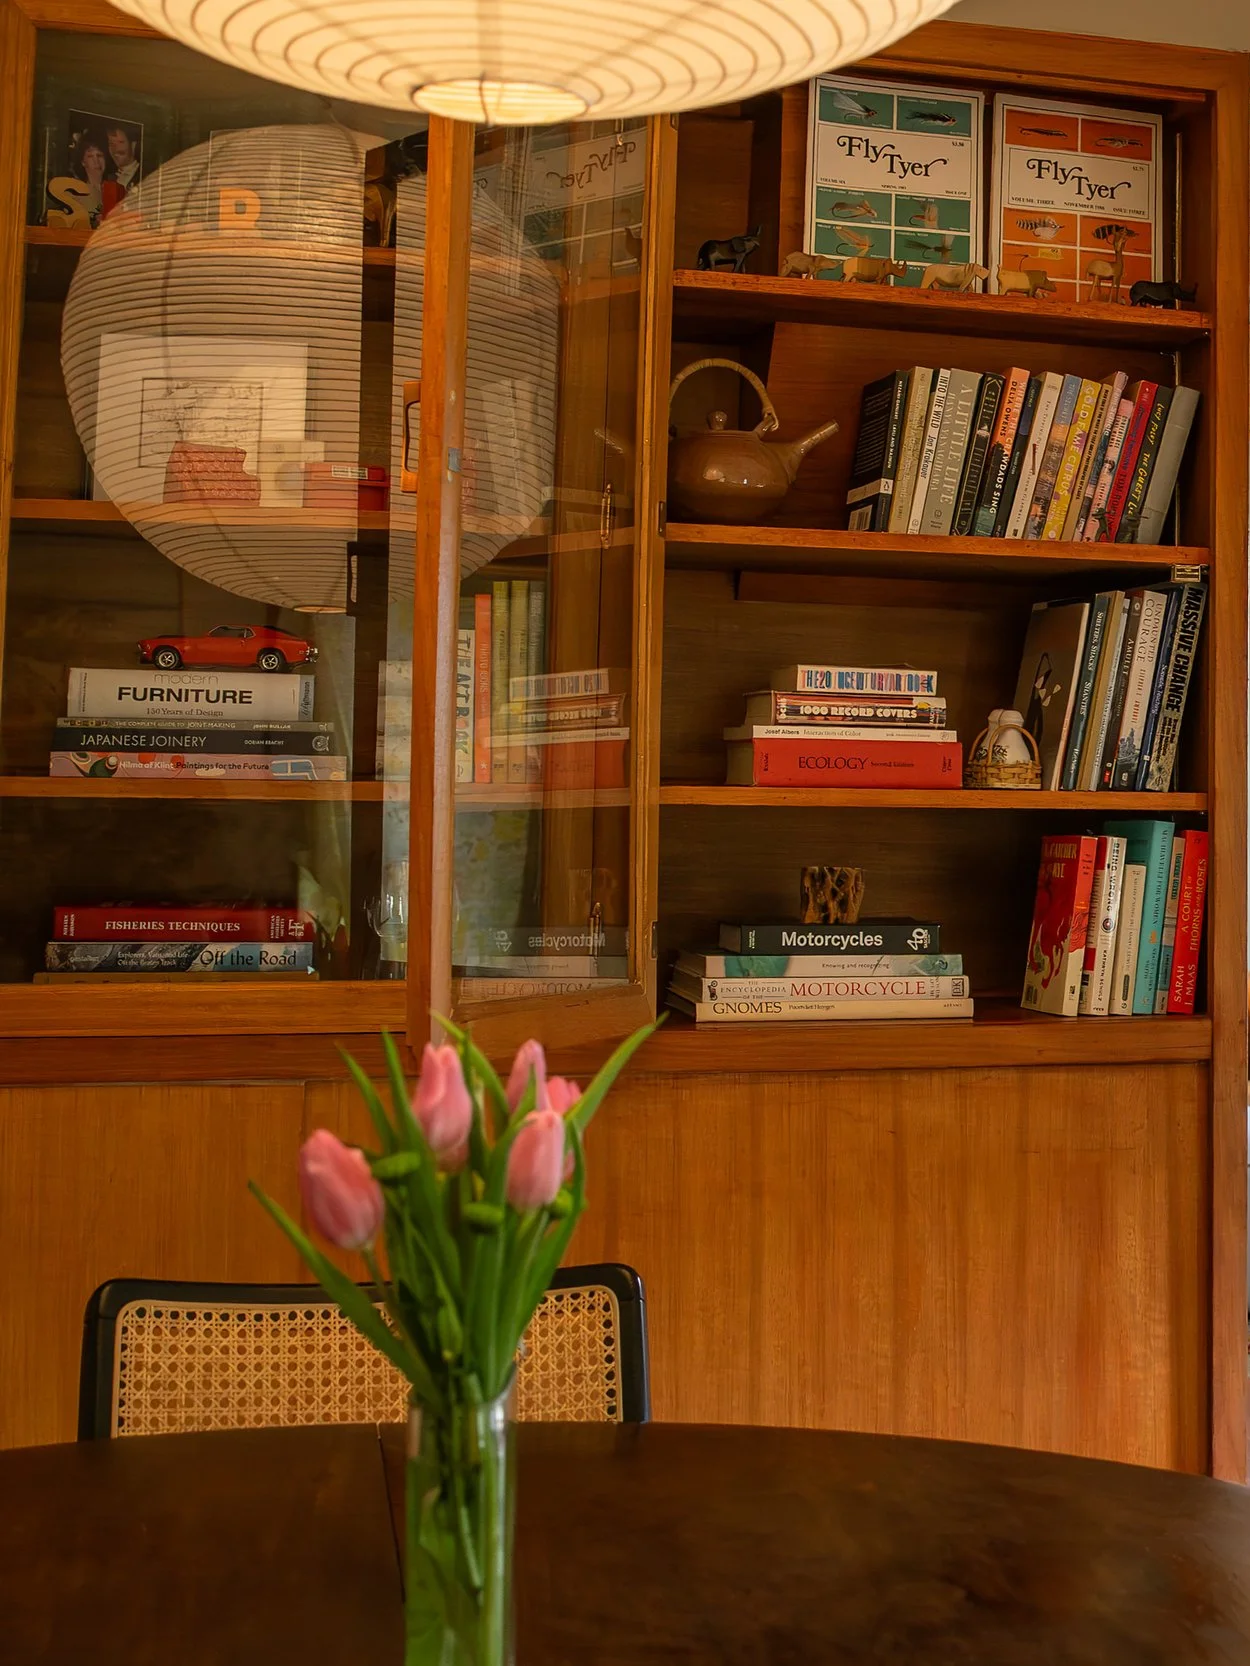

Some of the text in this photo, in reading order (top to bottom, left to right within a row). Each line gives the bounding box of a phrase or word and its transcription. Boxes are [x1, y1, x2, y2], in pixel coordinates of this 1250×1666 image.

[836, 135, 896, 163] Fly
[882, 153, 948, 179] Tyer
[1026, 158, 1083, 185] Fly
[1070, 175, 1132, 200] Tyer
[929, 374, 949, 429] INTO THE WILD
[998, 380, 1018, 438] DELIA OWENS
[1011, 381, 1026, 414] WHERE
[1078, 386, 1095, 421] GOLD
[1007, 415, 1018, 434] THE
[1069, 420, 1086, 453] FAME
[1145, 402, 1165, 445] LUCY FOLEY
[919, 434, 935, 480] Jon Krakauer
[929, 391, 956, 492] HANYA YANAGIHARA
[939, 384, 974, 506] A LITTLE LIFE
[993, 436, 1013, 490] CRAWDADS
[1058, 454, 1077, 497] CITRUS
[1124, 451, 1150, 518] THE GUEST LIS
[987, 490, 1001, 515] SING
[1136, 597, 1155, 663] COURAGE
[1145, 602, 1163, 663] UNDAUNTED
[1165, 586, 1204, 713] MASSIVE CHANGE
[154, 671, 220, 684] modern
[117, 686, 253, 705] FURNITURE
[146, 707, 224, 717] 150 Years of Design
[799, 704, 829, 716] 1000
[830, 705, 875, 718] RECORD
[876, 706, 918, 719] COVERS
[80, 734, 208, 748] JAPANESE JOINERY
[119, 760, 144, 769] Hilma
[176, 761, 214, 772] Paintings
[215, 761, 227, 770] for
[227, 762, 242, 770] the
[242, 762, 269, 771] Future
[798, 756, 868, 770] ECOLOGY
[1106, 842, 1120, 912] BEING WRONG
[1194, 857, 1206, 893] ROSES
[1180, 883, 1193, 934] A COURT
[104, 920, 240, 933] FISHERIES TECHNIQUES
[781, 931, 883, 951] Motorcycles
[906, 927, 924, 951] 40
[1189, 907, 1201, 951] THORNS
[199, 950, 296, 965] Off the Road
[720, 986, 787, 994] ENCYCLOPEDIA
[789, 980, 926, 997] MOTORCYCLE
[1172, 964, 1185, 1003] SARAH
[1184, 962, 1196, 996] MAAS
[712, 1001, 782, 1015] GNOMES
